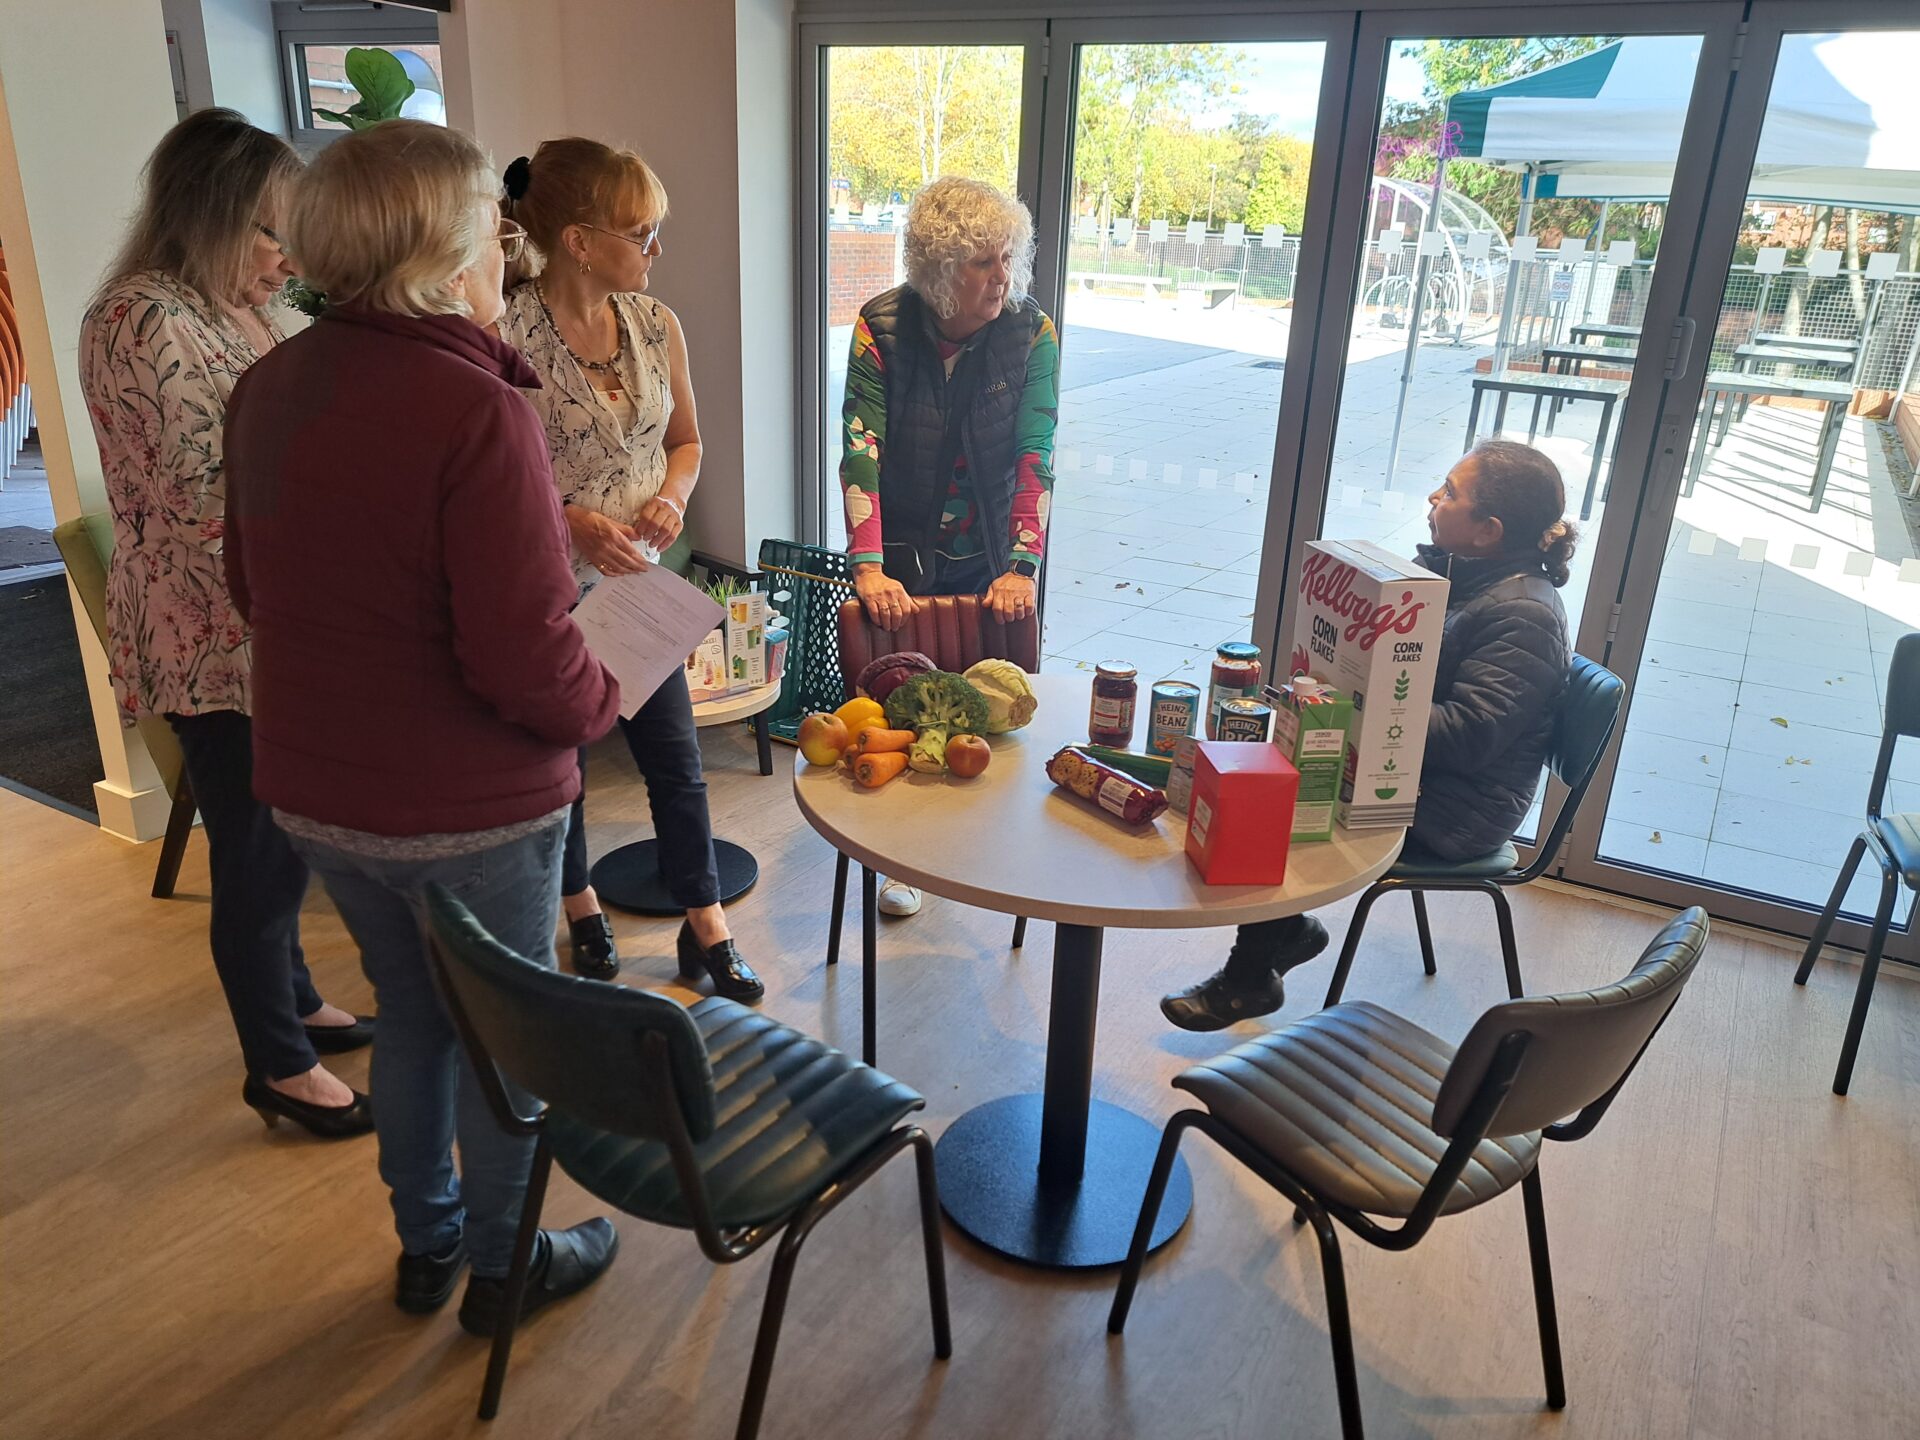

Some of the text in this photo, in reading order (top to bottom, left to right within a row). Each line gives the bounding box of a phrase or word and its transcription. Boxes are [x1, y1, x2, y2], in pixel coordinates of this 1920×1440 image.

[1300, 553, 1425, 651] Kellogg's
[1312, 614, 1338, 647] CORN
[1311, 637, 1335, 664] FLAKES
[1394, 642, 1423, 653] CORN
[1392, 653, 1421, 662] FLAKES
[1160, 703, 1186, 713] HEINZ
[1156, 714, 1188, 727] BEANZ
[1228, 720, 1258, 730] HEINZ
